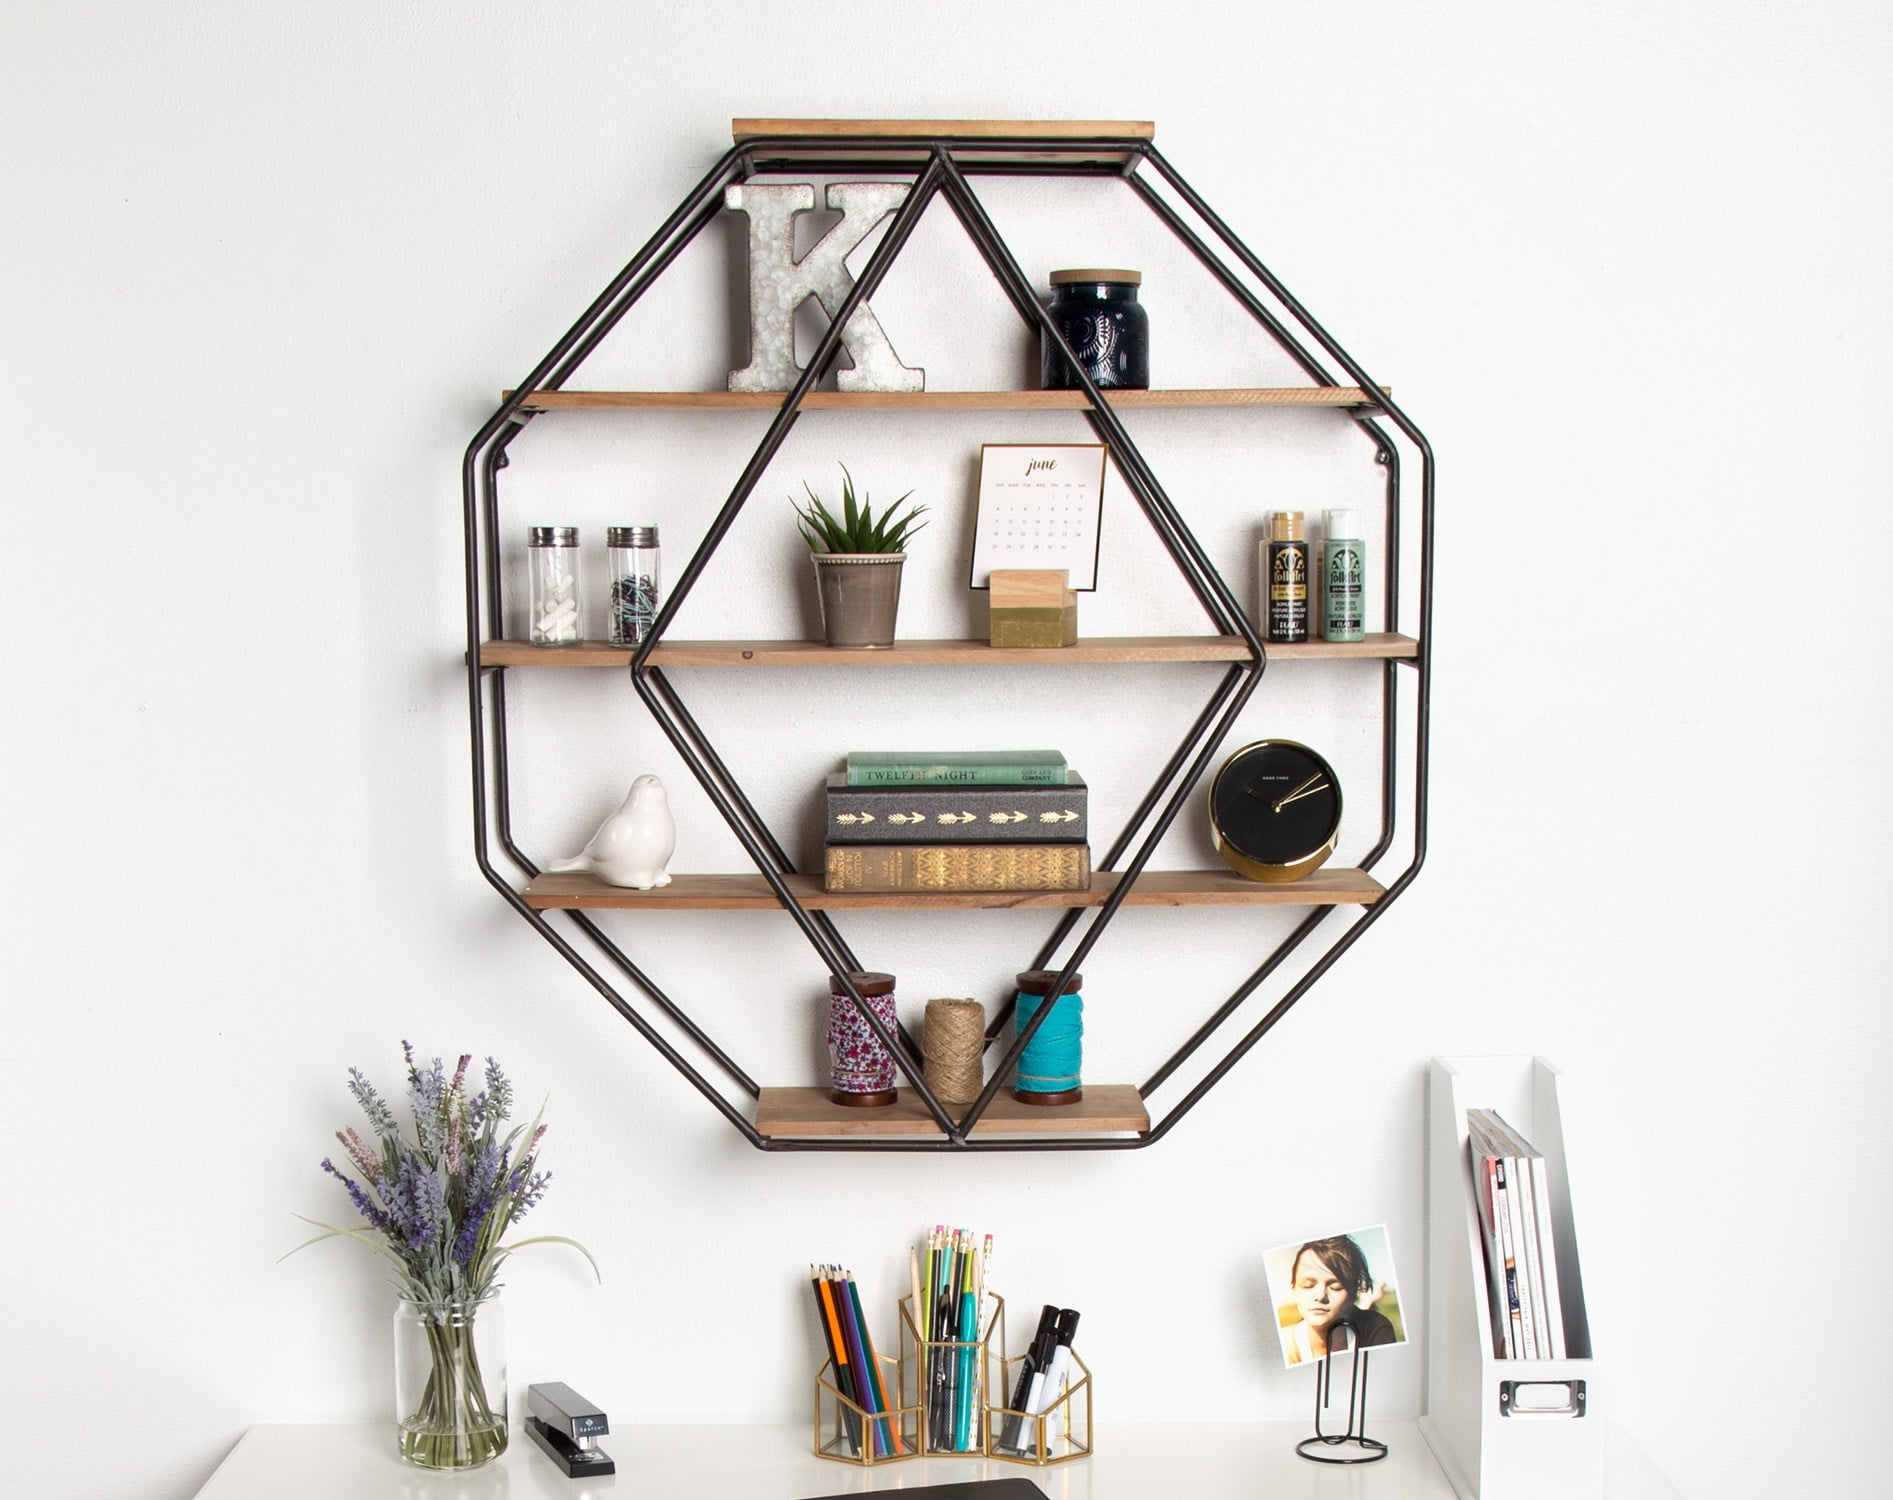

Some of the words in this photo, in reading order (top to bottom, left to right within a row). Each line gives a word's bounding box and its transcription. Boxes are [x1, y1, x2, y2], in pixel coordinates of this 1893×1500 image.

[725, 183, 925, 392] K
[1025, 458, 1059, 477] june
[866, 771, 926, 781] TWELFTH
[935, 771, 978, 781] NIGHT
